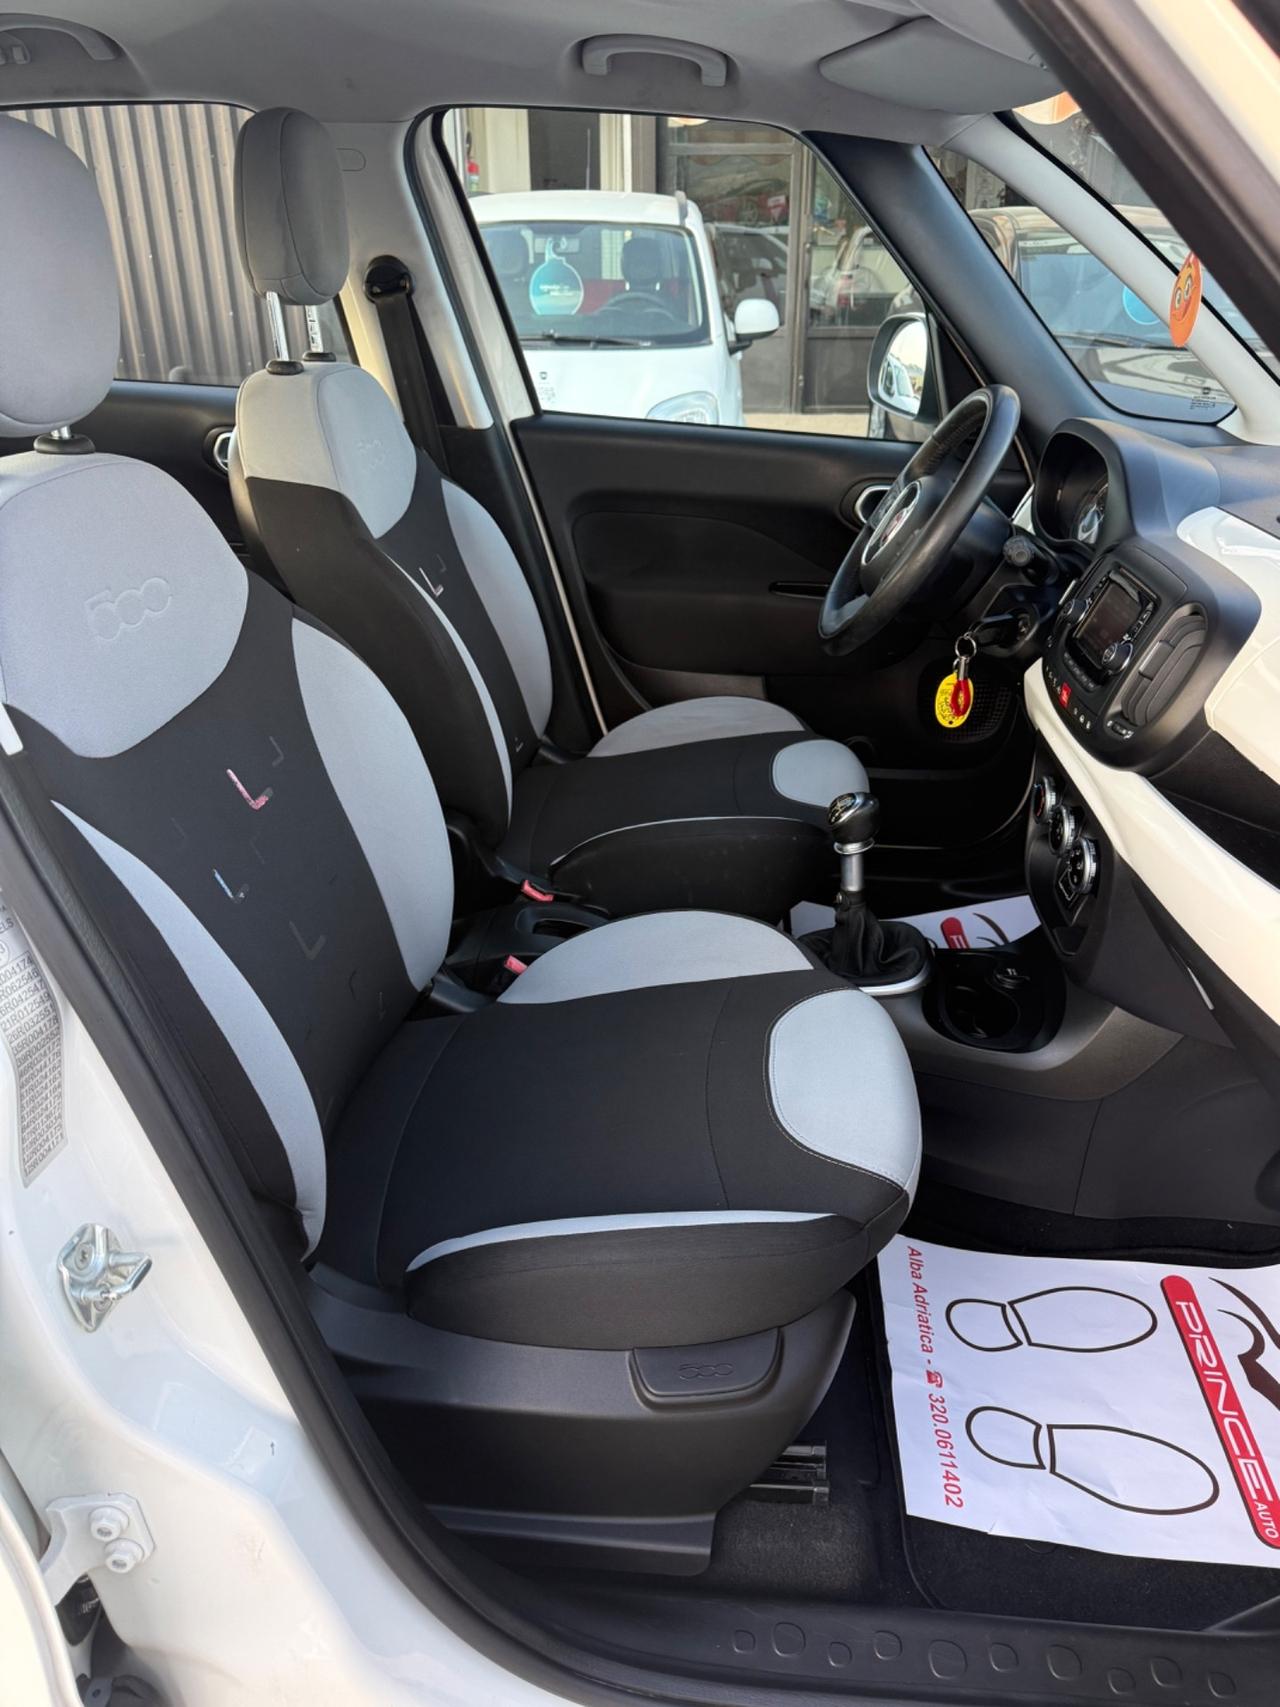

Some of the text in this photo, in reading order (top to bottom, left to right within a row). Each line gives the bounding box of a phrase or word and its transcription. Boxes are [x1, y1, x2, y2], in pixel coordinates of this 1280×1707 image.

[908, 1245, 924, 1280] Alba
[912, 1282, 935, 1354] Adriatica
[928, 1392, 964, 1509] 320.0611402
[1175, 1300, 1279, 1540] PRINCE AUTO
